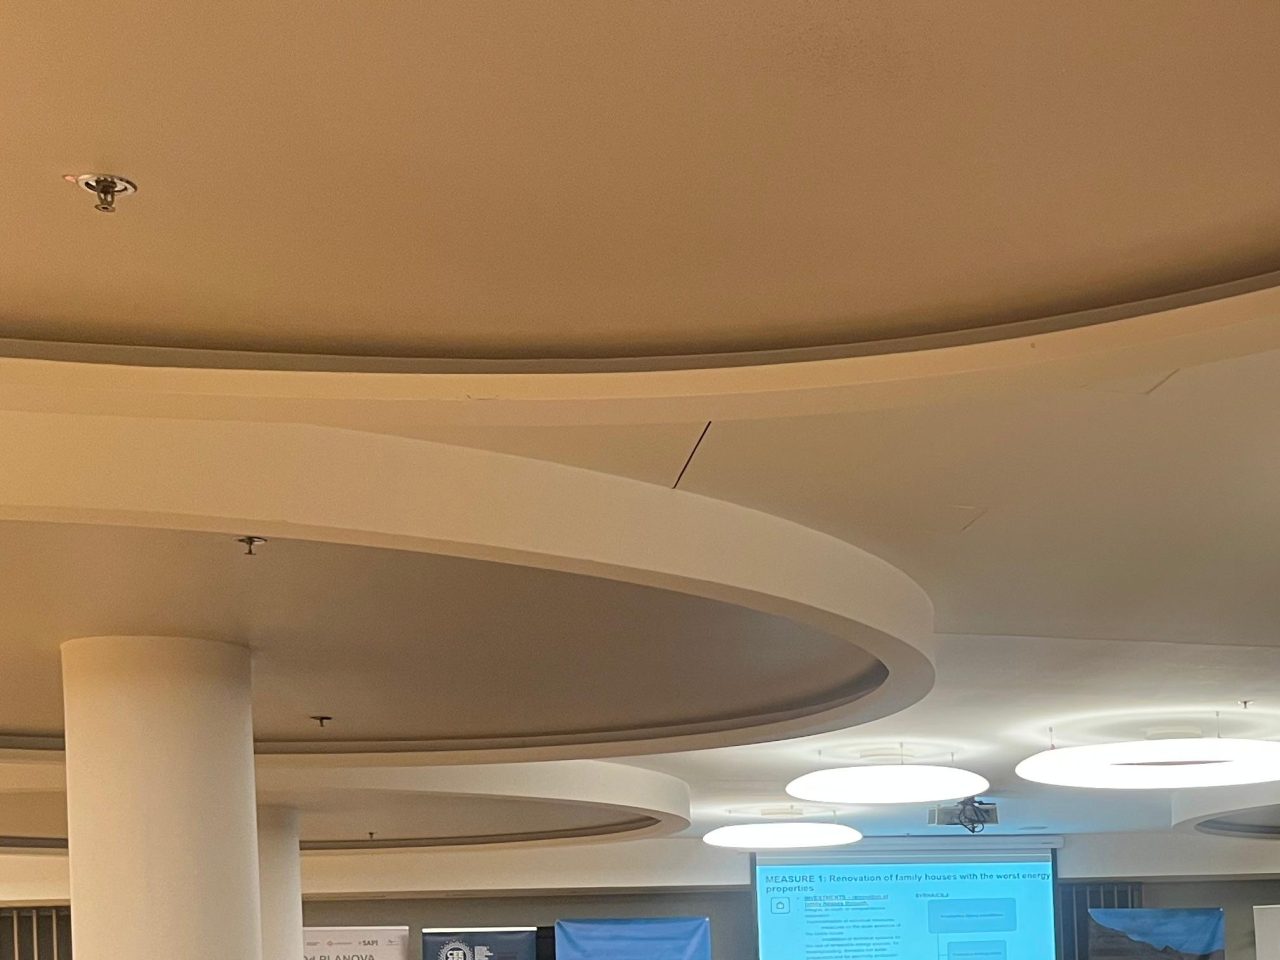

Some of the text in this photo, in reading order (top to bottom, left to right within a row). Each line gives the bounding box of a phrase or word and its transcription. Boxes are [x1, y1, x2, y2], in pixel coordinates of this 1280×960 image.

[766, 875, 815, 883] MEASURE
[829, 874, 881, 883] Renovation
[883, 874, 893, 882] of
[895, 874, 922, 882] family
[1022, 873, 1050, 881] energy
[766, 885, 814, 894] properties
